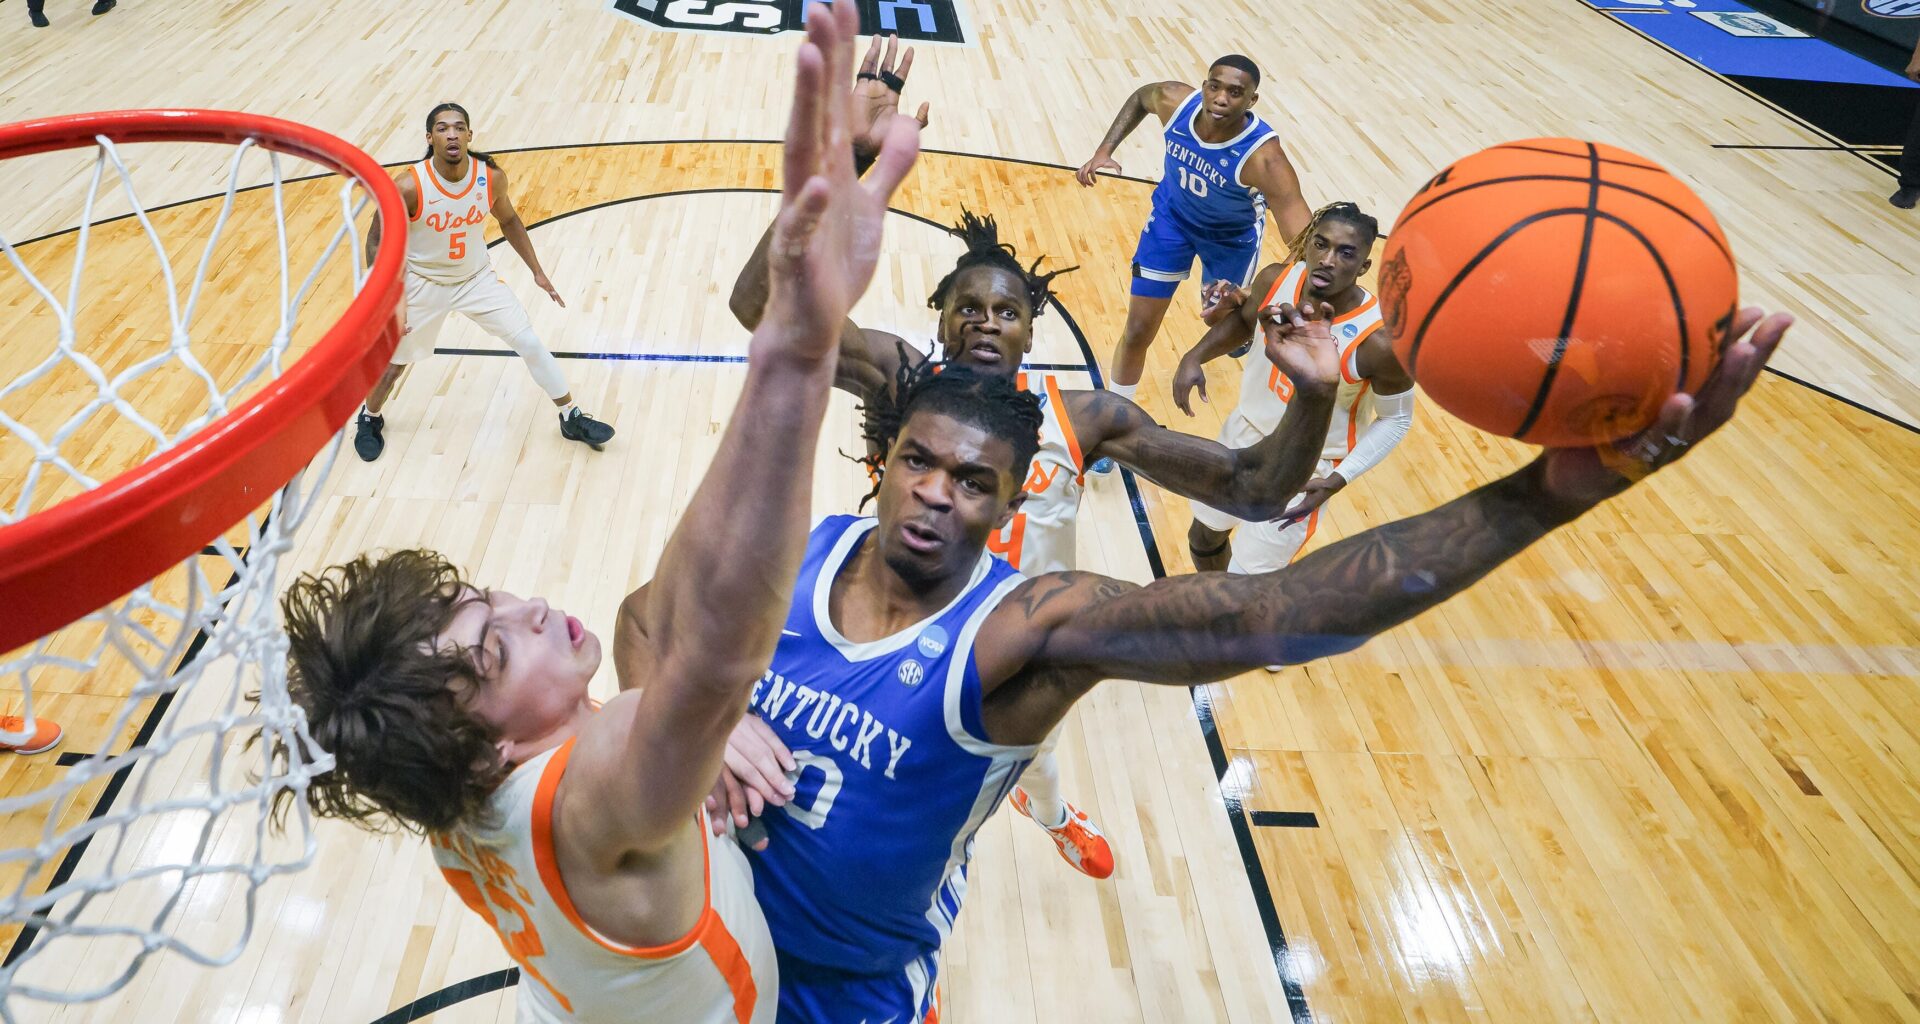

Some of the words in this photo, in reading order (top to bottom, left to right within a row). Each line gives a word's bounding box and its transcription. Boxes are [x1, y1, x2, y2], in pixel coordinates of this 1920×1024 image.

[1167, 139, 1227, 188] KENTUCKY
[1178, 166, 1208, 198] 10
[426, 204, 488, 232] Vols
[448, 231, 467, 260] 5
[900, 661, 922, 685] SEC
[751, 668, 912, 781] ENTUCKY
